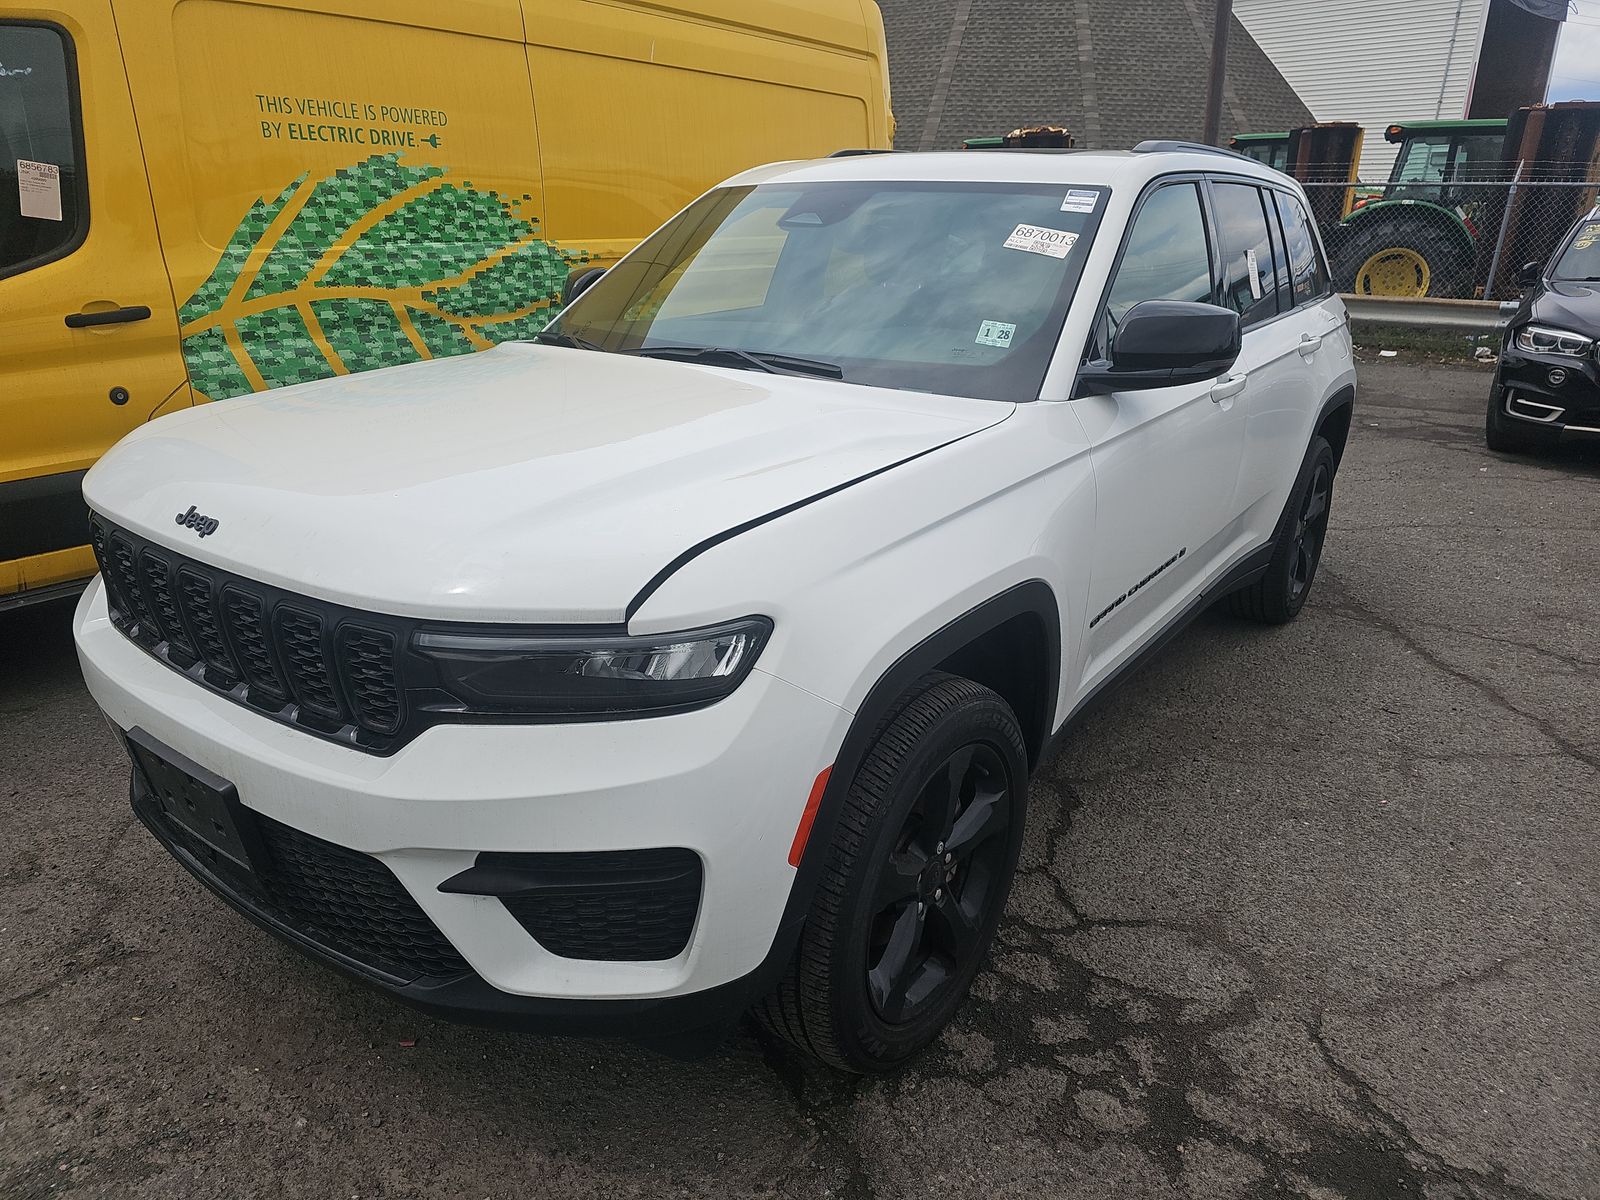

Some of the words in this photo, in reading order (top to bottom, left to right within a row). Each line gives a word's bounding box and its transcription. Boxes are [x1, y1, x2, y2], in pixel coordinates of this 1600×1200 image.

[256, 95, 293, 114] THIS
[295, 98, 360, 120] VEHICLE
[364, 103, 377, 121] IS
[381, 105, 448, 127] POWERED
[261, 121, 282, 139] BY
[288, 123, 365, 144] ELECTRIC
[370, 129, 420, 148] DRIVE.
[19, 161, 59, 175] 6856783
[1016, 226, 1077, 246] 6870013
[984, 327, 991, 338] 1
[997, 329, 1011, 340] 28
[174, 504, 220, 539] Jeep
